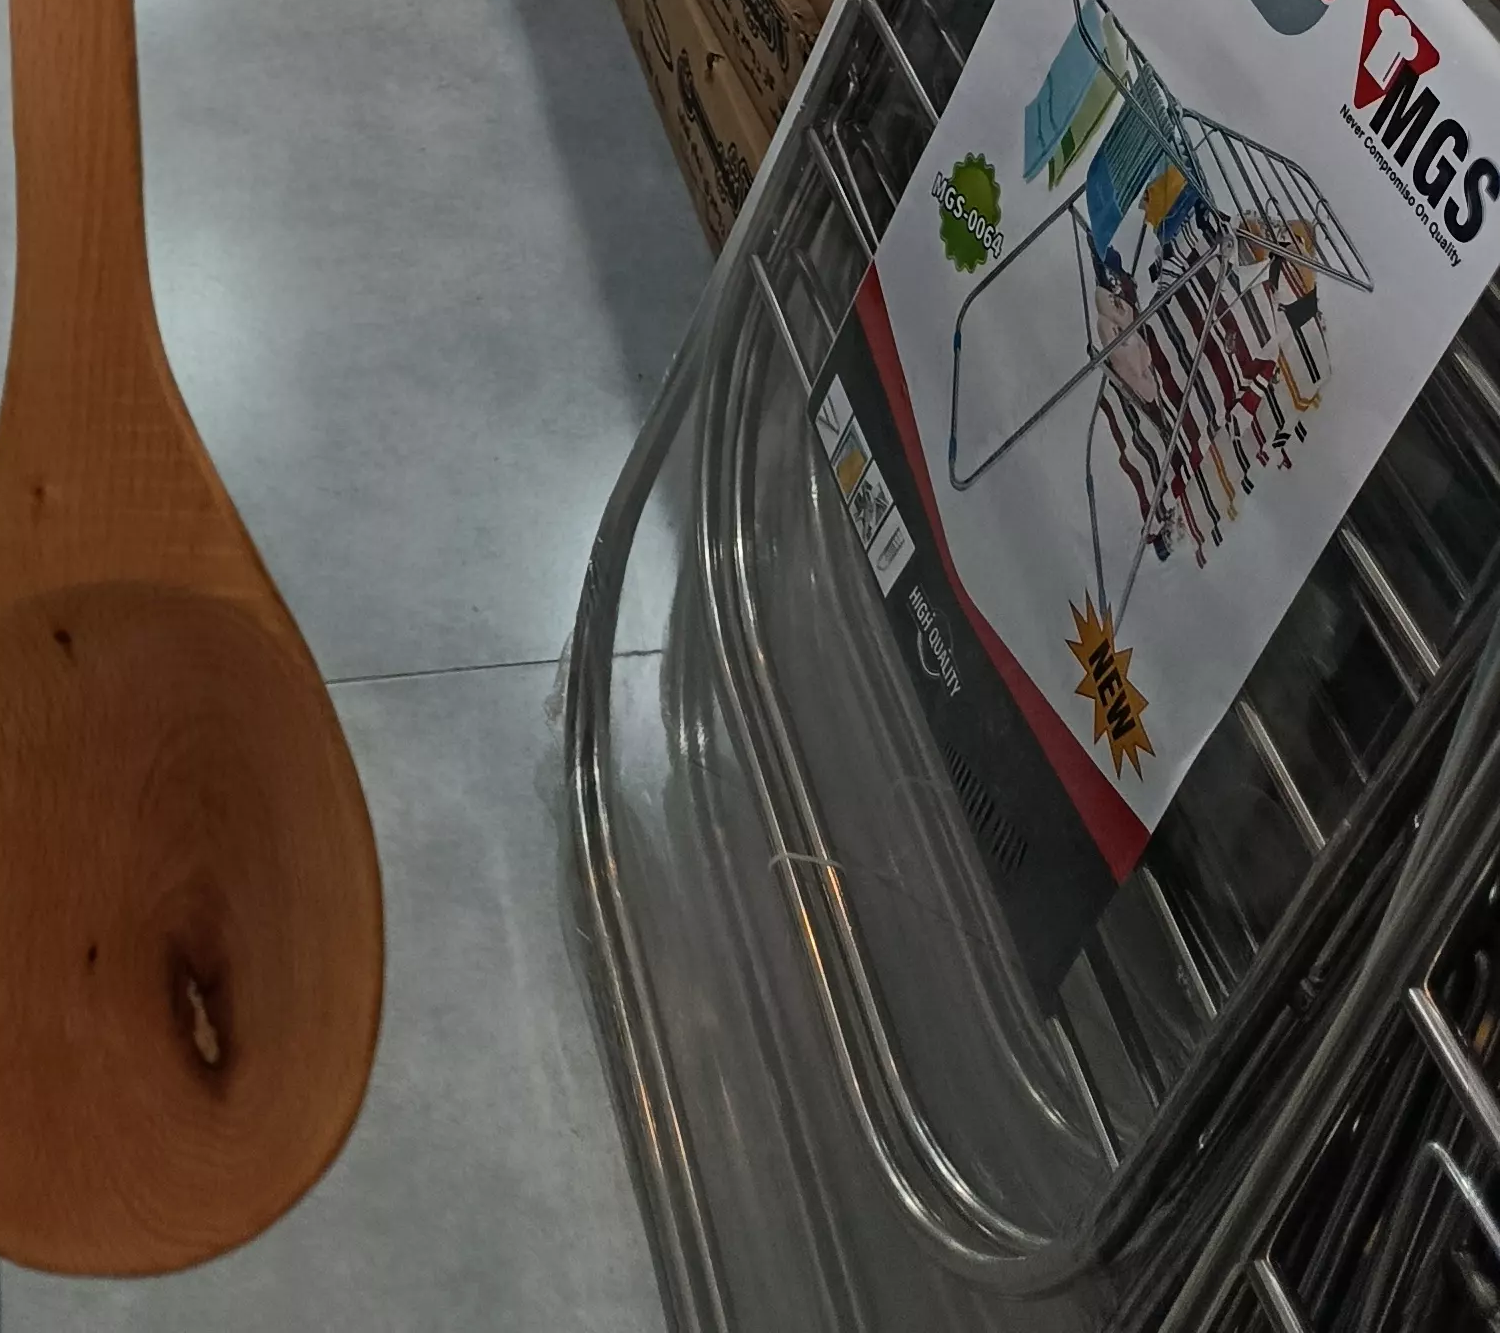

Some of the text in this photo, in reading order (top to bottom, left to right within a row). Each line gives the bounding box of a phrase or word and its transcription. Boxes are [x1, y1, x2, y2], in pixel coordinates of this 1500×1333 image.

[1339, 103, 1366, 139] Never
[1415, 202, 1429, 226] On
[1428, 221, 1462, 268] Quality
[1368, 56, 1500, 244] MGS
[931, 171, 1004, 259] MGS-0064
[908, 585, 961, 698] HIGH QUALITY
[1088, 637, 1136, 741] NEW
